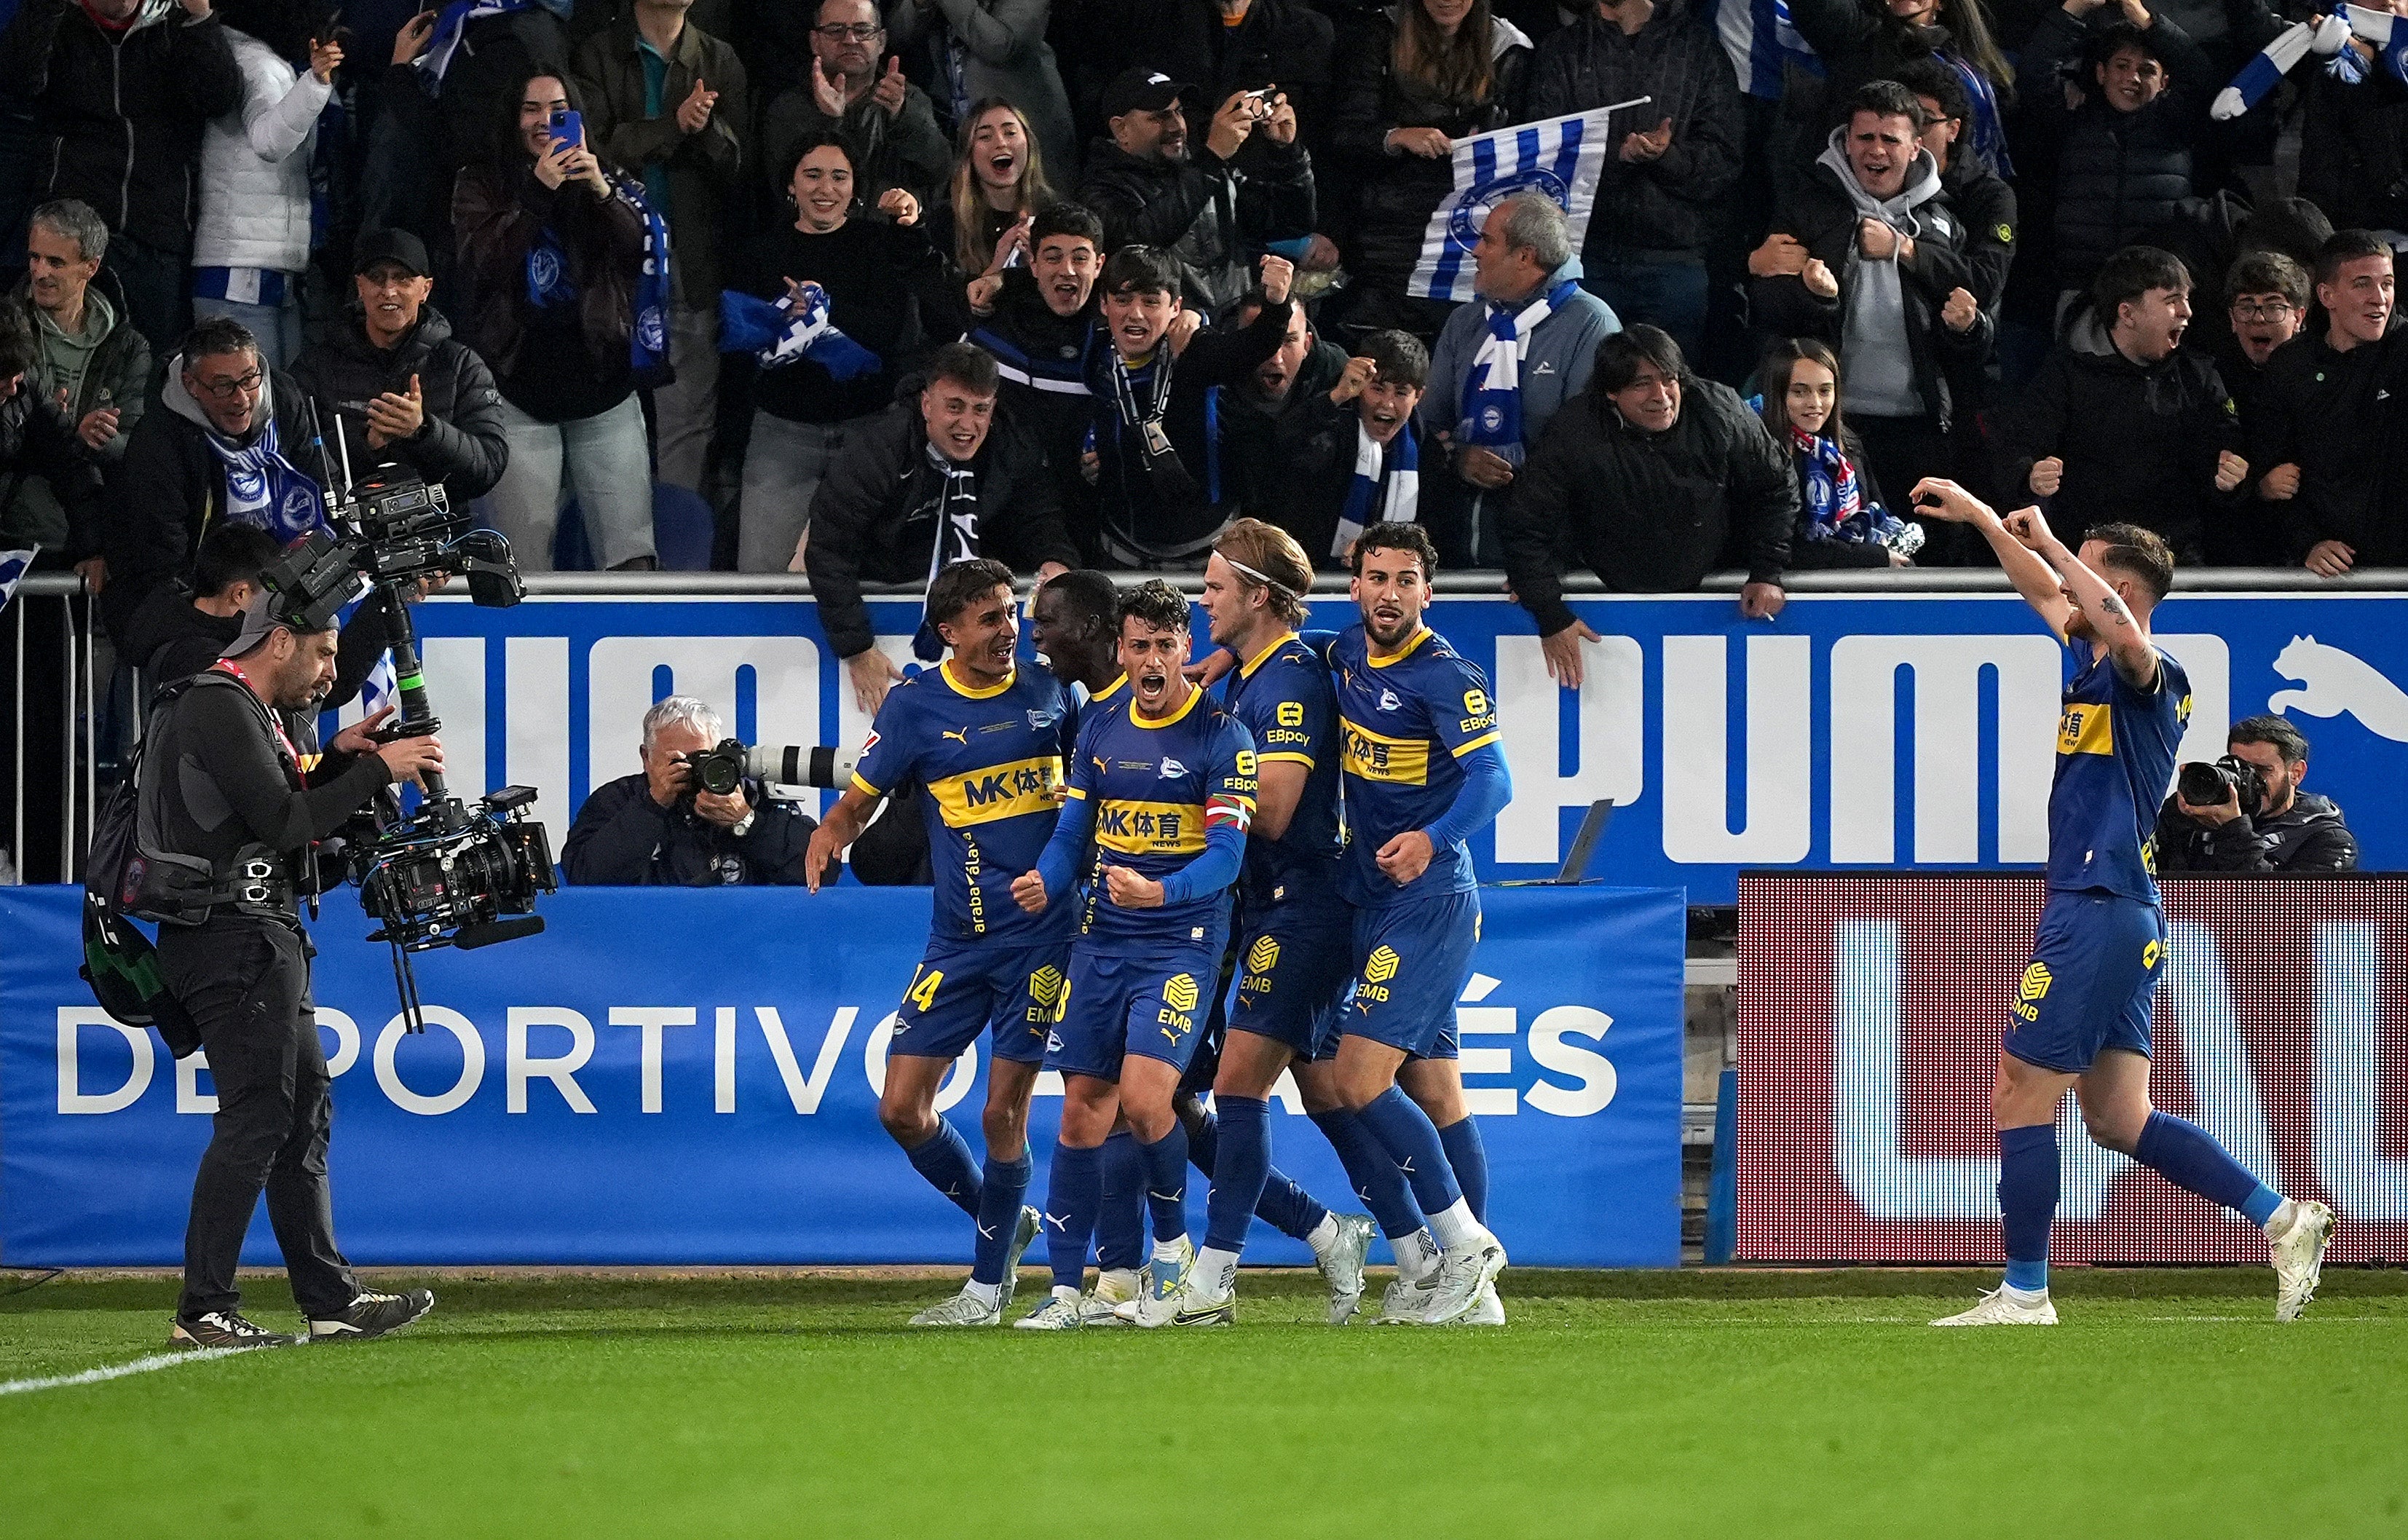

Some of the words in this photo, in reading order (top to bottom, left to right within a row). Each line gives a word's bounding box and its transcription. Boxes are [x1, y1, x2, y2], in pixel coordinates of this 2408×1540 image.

[1266, 729, 1310, 747] EBpay
[902, 963, 944, 1012] 14
[1240, 976, 1272, 994] EMB
[1356, 983, 1390, 1003] EMB
[1027, 1006, 1054, 1023] EM
[2012, 995, 2040, 1023] EMB
[1158, 1008, 1192, 1034] EMB
